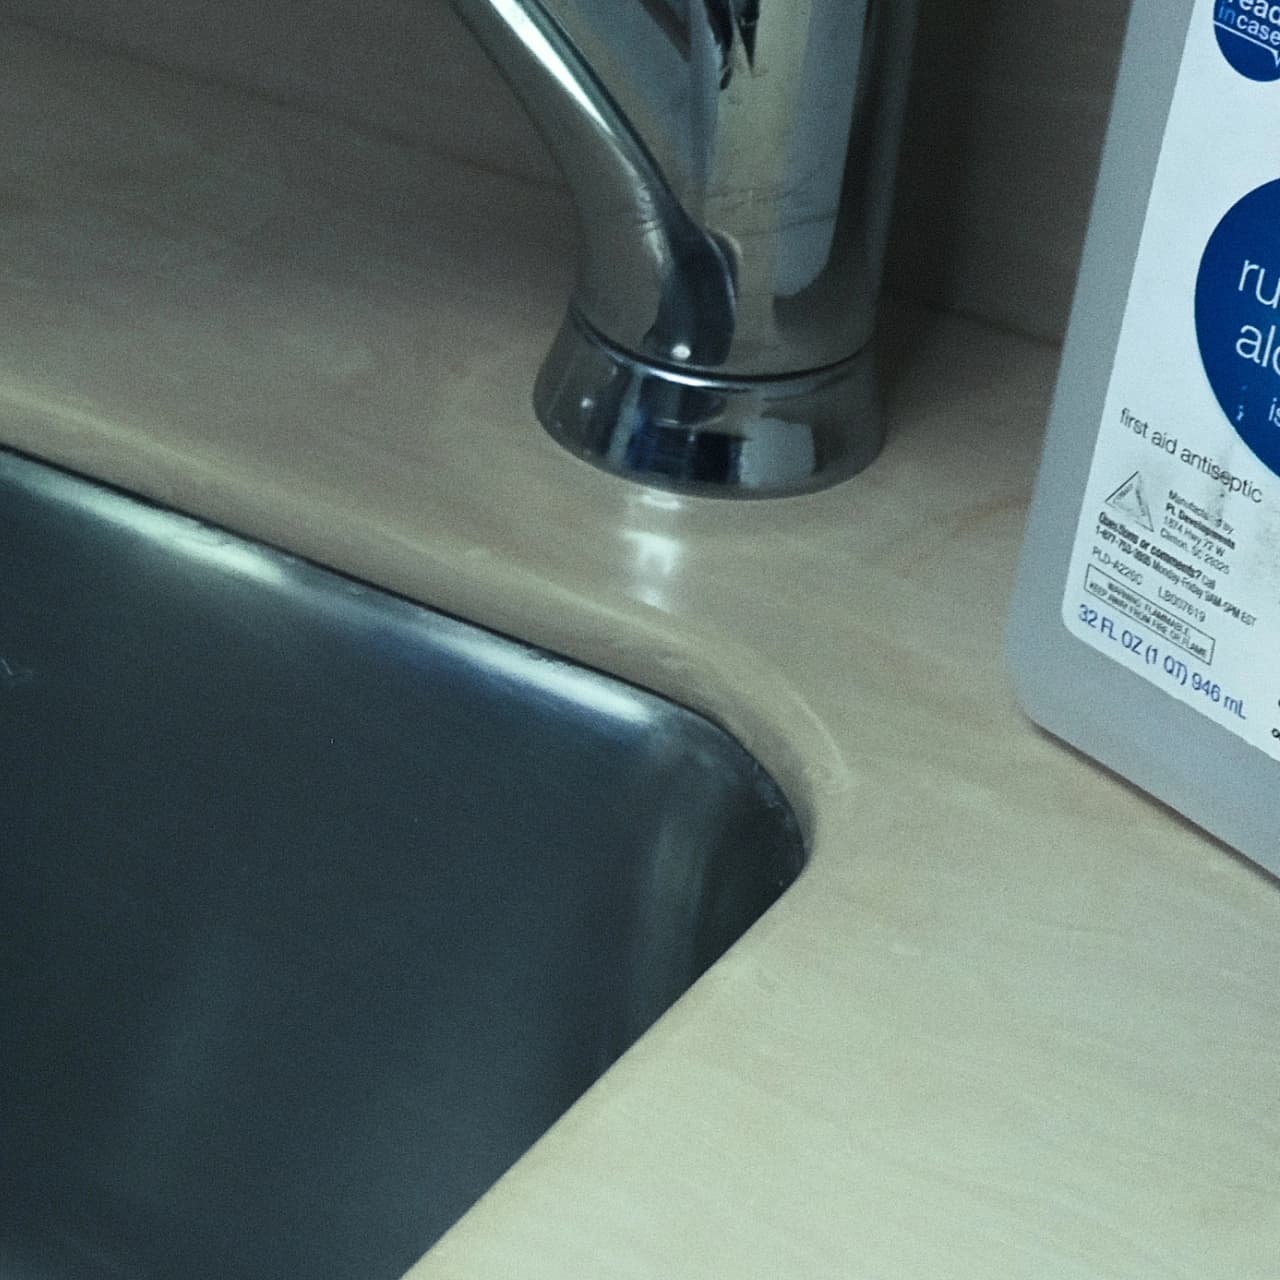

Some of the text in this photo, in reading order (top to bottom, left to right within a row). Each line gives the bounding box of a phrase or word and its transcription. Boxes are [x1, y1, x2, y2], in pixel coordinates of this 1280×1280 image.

[1119, 407, 1149, 438] first
[1151, 431, 1178, 455] aid
[1180, 447, 1263, 503] antiseptic
[1078, 603, 1098, 629] 32
[1101, 616, 1118, 641] FL
[1121, 629, 1143, 655] OZ
[1145, 645, 1158, 665] (1
[1163, 655, 1188, 686] QT)
[1191, 671, 1221, 702] 946
[1223, 695, 1247, 720] mL
